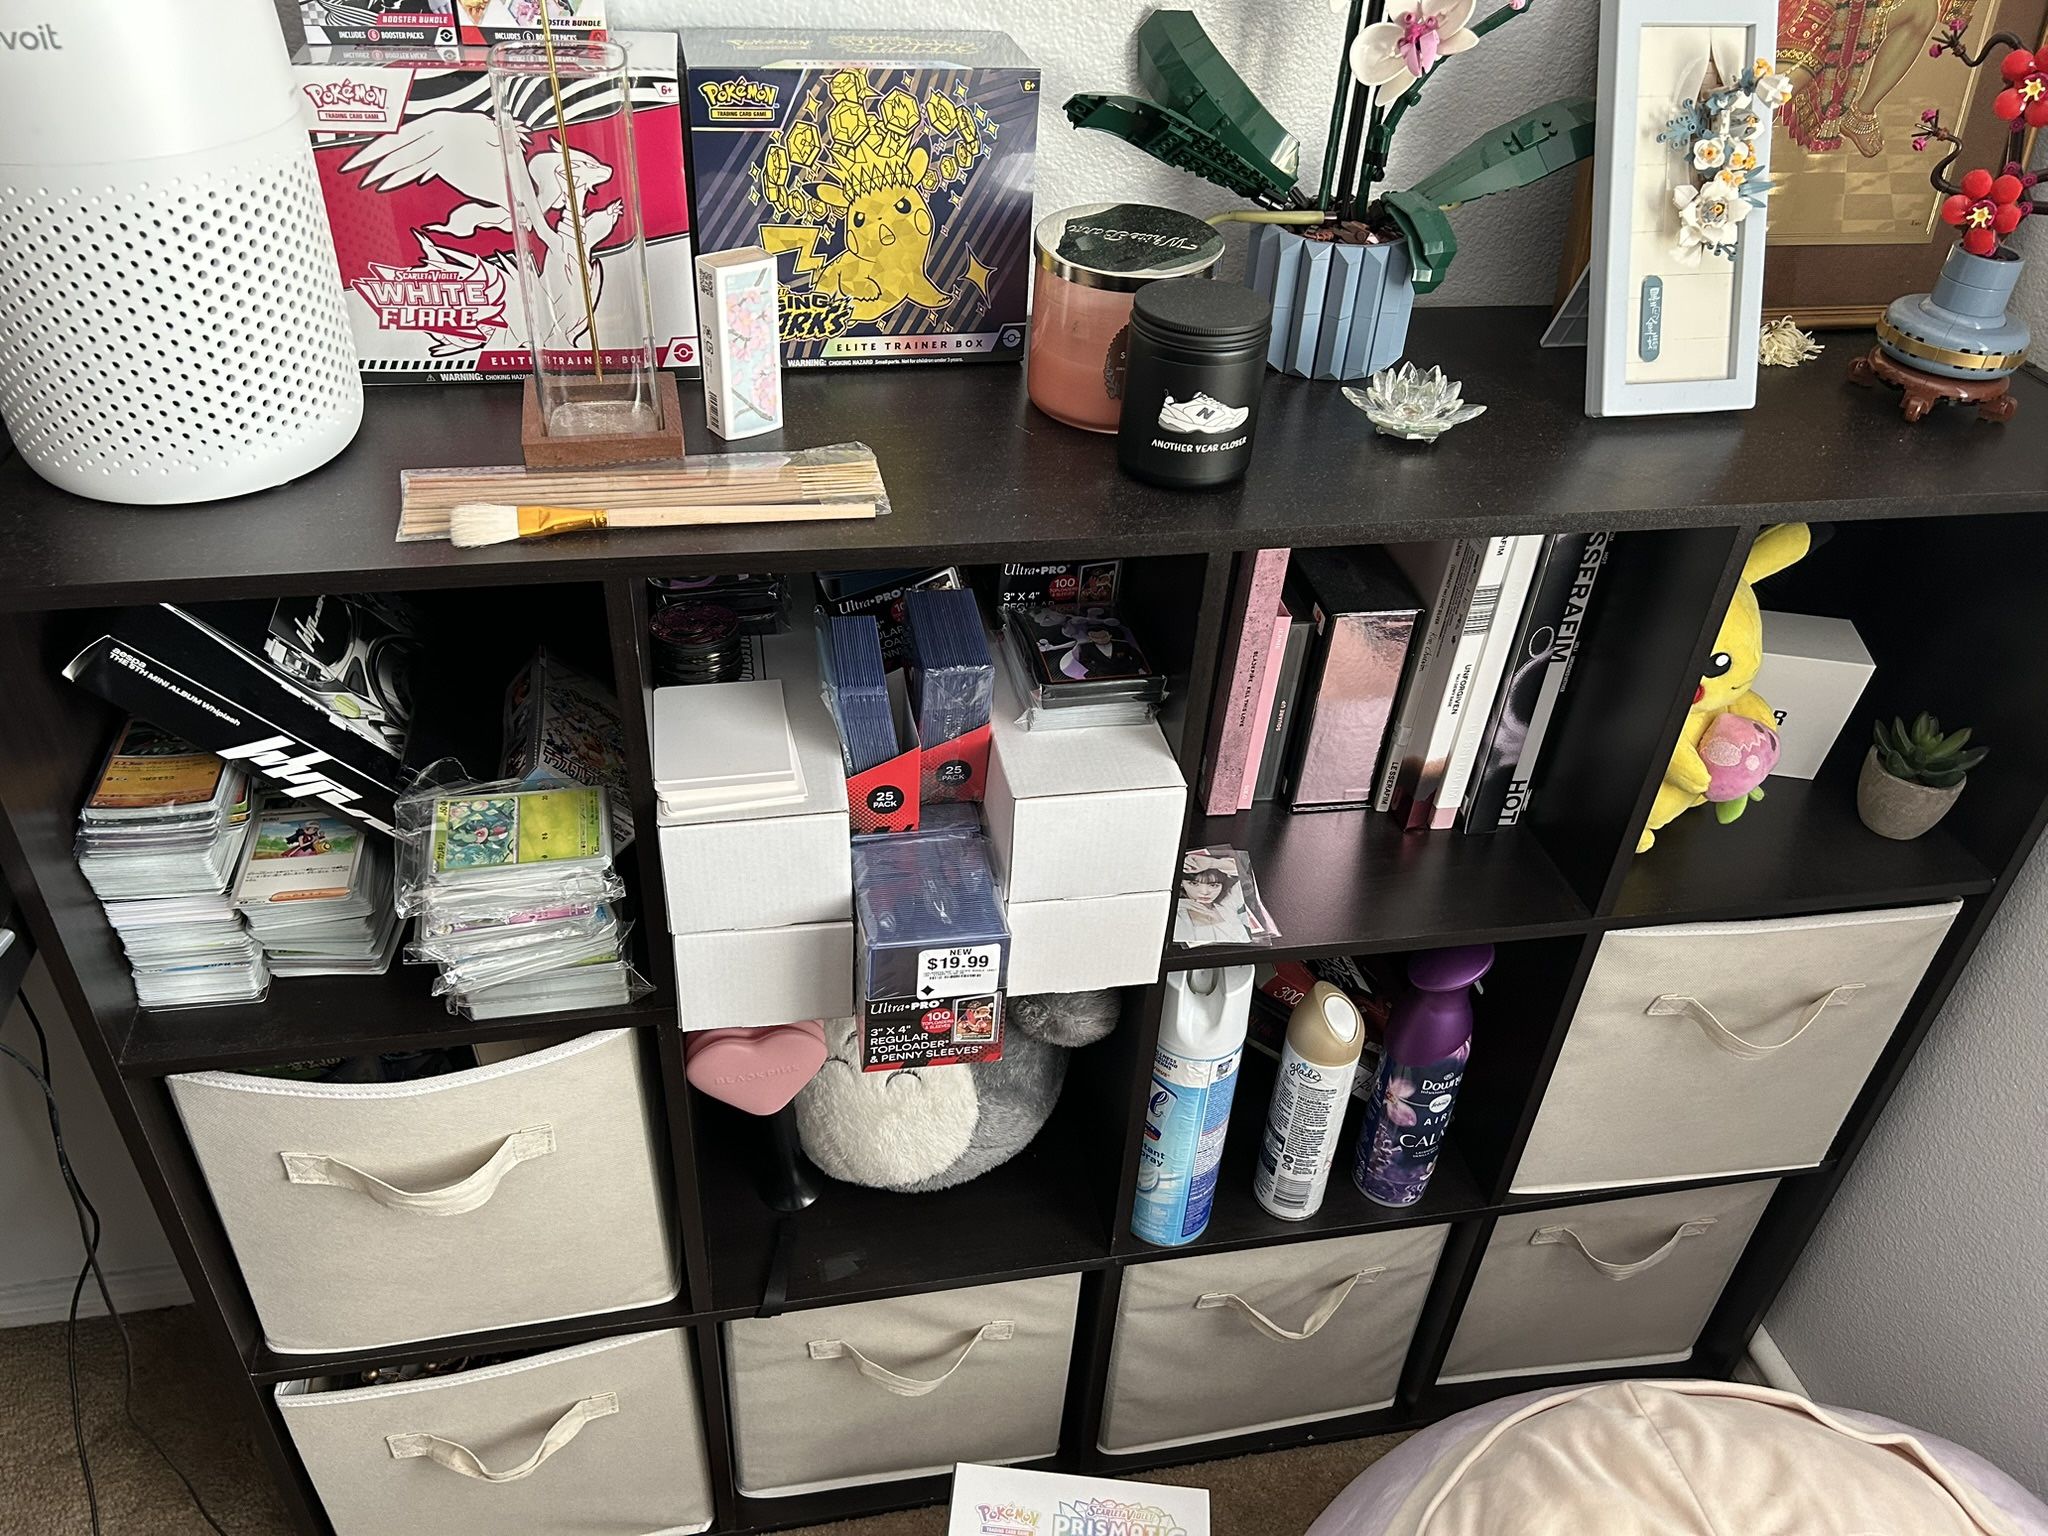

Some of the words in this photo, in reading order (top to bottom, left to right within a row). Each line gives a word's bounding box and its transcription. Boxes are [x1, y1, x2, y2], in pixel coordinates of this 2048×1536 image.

[382, 15, 417, 24] BOOSTER
[419, 15, 448, 24] BUNDLE
[536, 18, 570, 26] BOSTER
[572, 19, 601, 27] BUNDLE
[0, 24, 63, 50] voit
[338, 31, 367, 39] INCLUDES
[381, 31, 406, 39] BOOSTER
[661, 85, 672, 95] 6+
[1024, 80, 1036, 91] 6+
[370, 282, 489, 306] WHITE
[381, 308, 479, 328] FLARE
[837, 342, 877, 352] ELITE
[885, 340, 948, 351] TRAINER
[956, 339, 983, 348] BOX
[553, 355, 613, 366] TRAINR
[787, 359, 827, 367] WARNING:
[440, 373, 484, 382] WARNING:
[1151, 438, 1193, 453] ANOTHER
[1196, 443, 1219, 453] YEAR
[1055, 578, 1075, 588] 100
[1004, 592, 1015, 601] 3"
[1028, 591, 1040, 600] 4"
[109, 652, 128, 666] THE
[128, 664, 149, 677] 5TH
[147, 673, 170, 688] MINI
[168, 685, 202, 705] ALBUM
[202, 701, 241, 726] Whiplash
[1451, 664, 1472, 715] UNFORGIVEN
[1280, 700, 1287, 709] UP
[1276, 709, 1285, 731] SQUARE
[945, 765, 962, 775] 25
[942, 773, 966, 781] PACK
[876, 791, 894, 801] 25
[873, 800, 897, 808] PACK
[1500, 780, 1528, 824] HOT
[949, 948, 973, 956] NEW
[927, 955, 989, 971] $19.99
[927, 1011, 951, 1021] 100
[871, 1027, 883, 1037] 3"
[886, 1026, 896, 1035] X
[899, 1025, 911, 1034] 4"
[870, 1033, 928, 1046] REGULAR
[870, 1055, 878, 1063] &
[881, 1052, 923, 1062] PENNY
